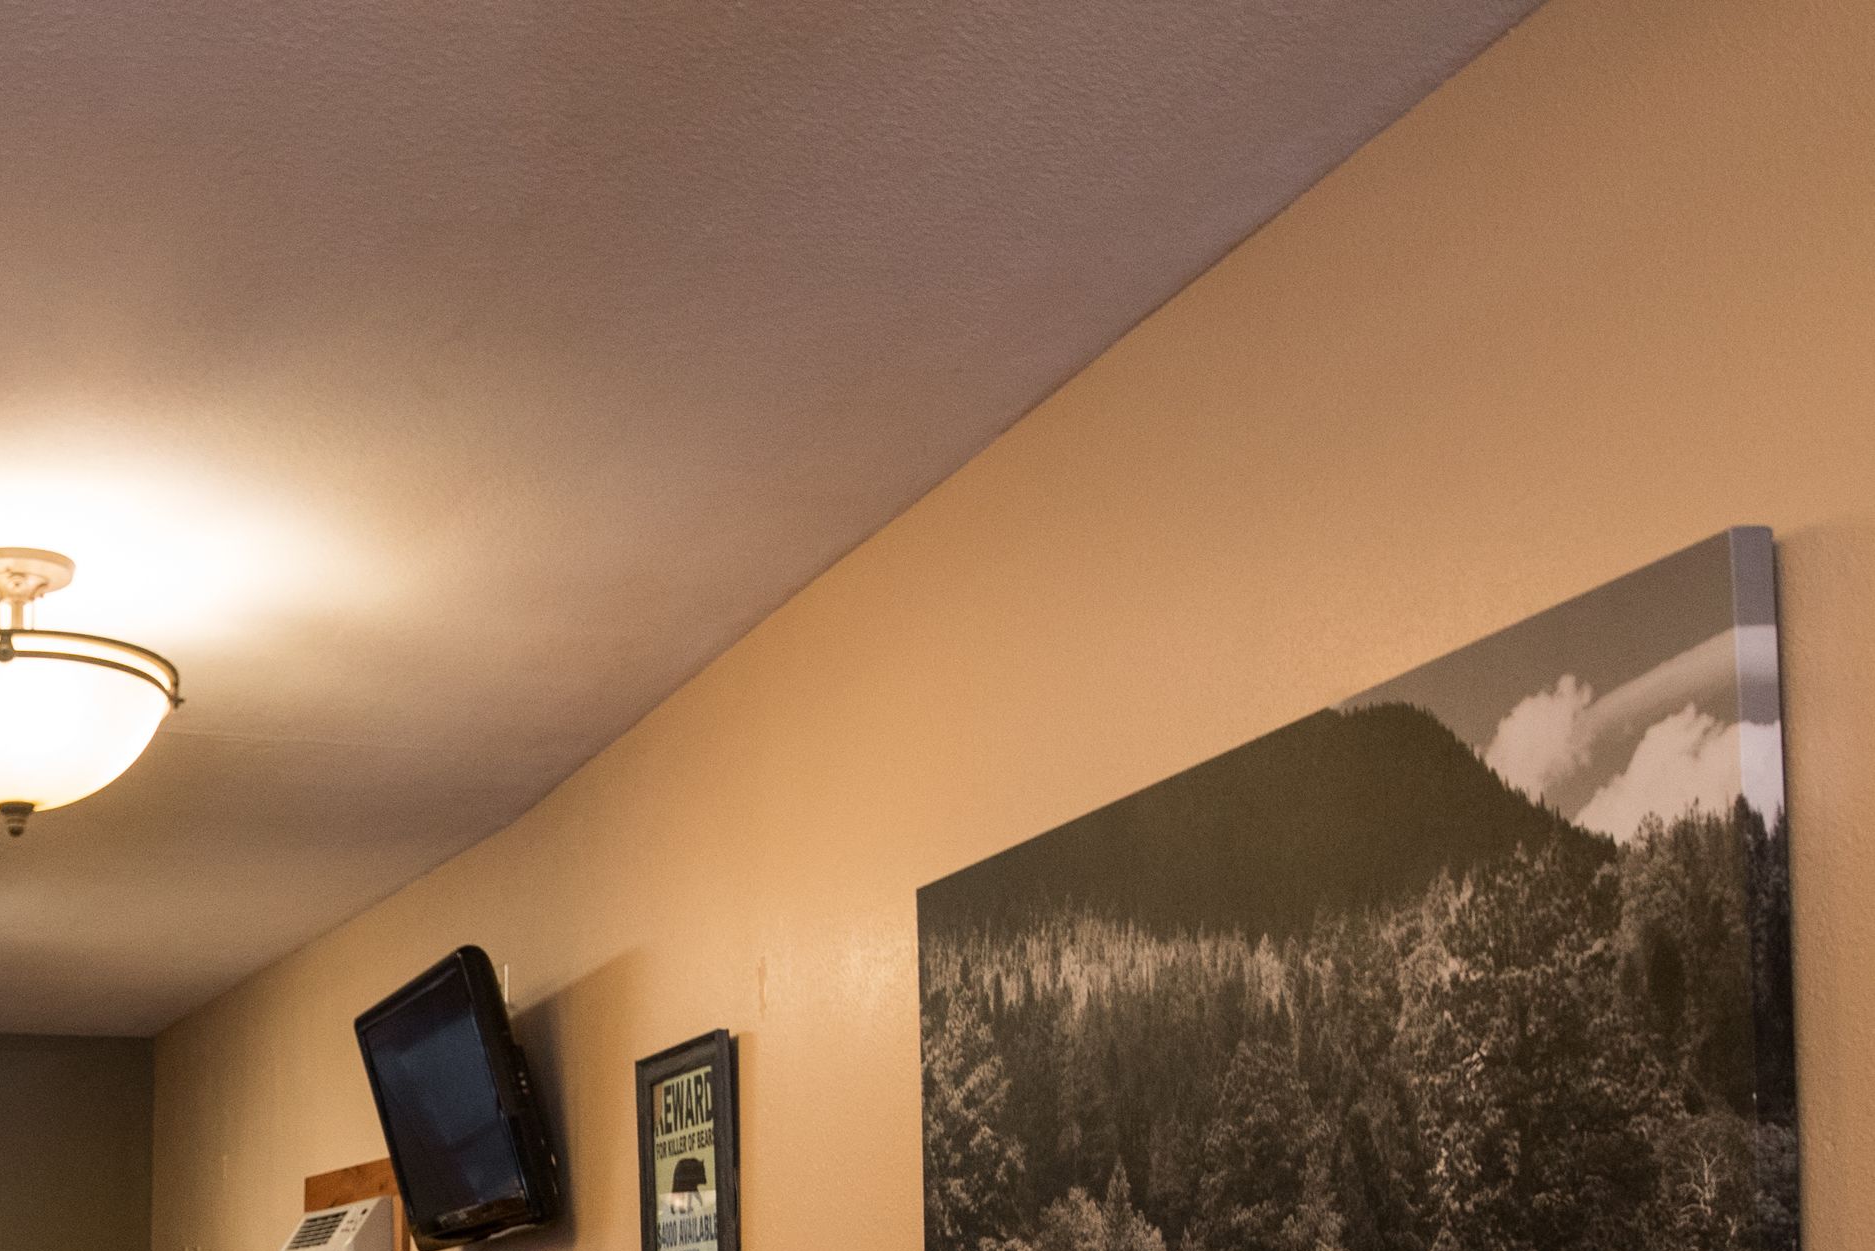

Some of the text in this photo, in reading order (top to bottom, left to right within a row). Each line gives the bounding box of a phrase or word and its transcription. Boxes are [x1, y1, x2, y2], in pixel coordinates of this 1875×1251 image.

[656, 1141, 667, 1160] FOR
[668, 1136, 687, 1156] KILLER
[688, 1132, 696, 1152] OF
[679, 1214, 718, 1245] AVAILABLE
